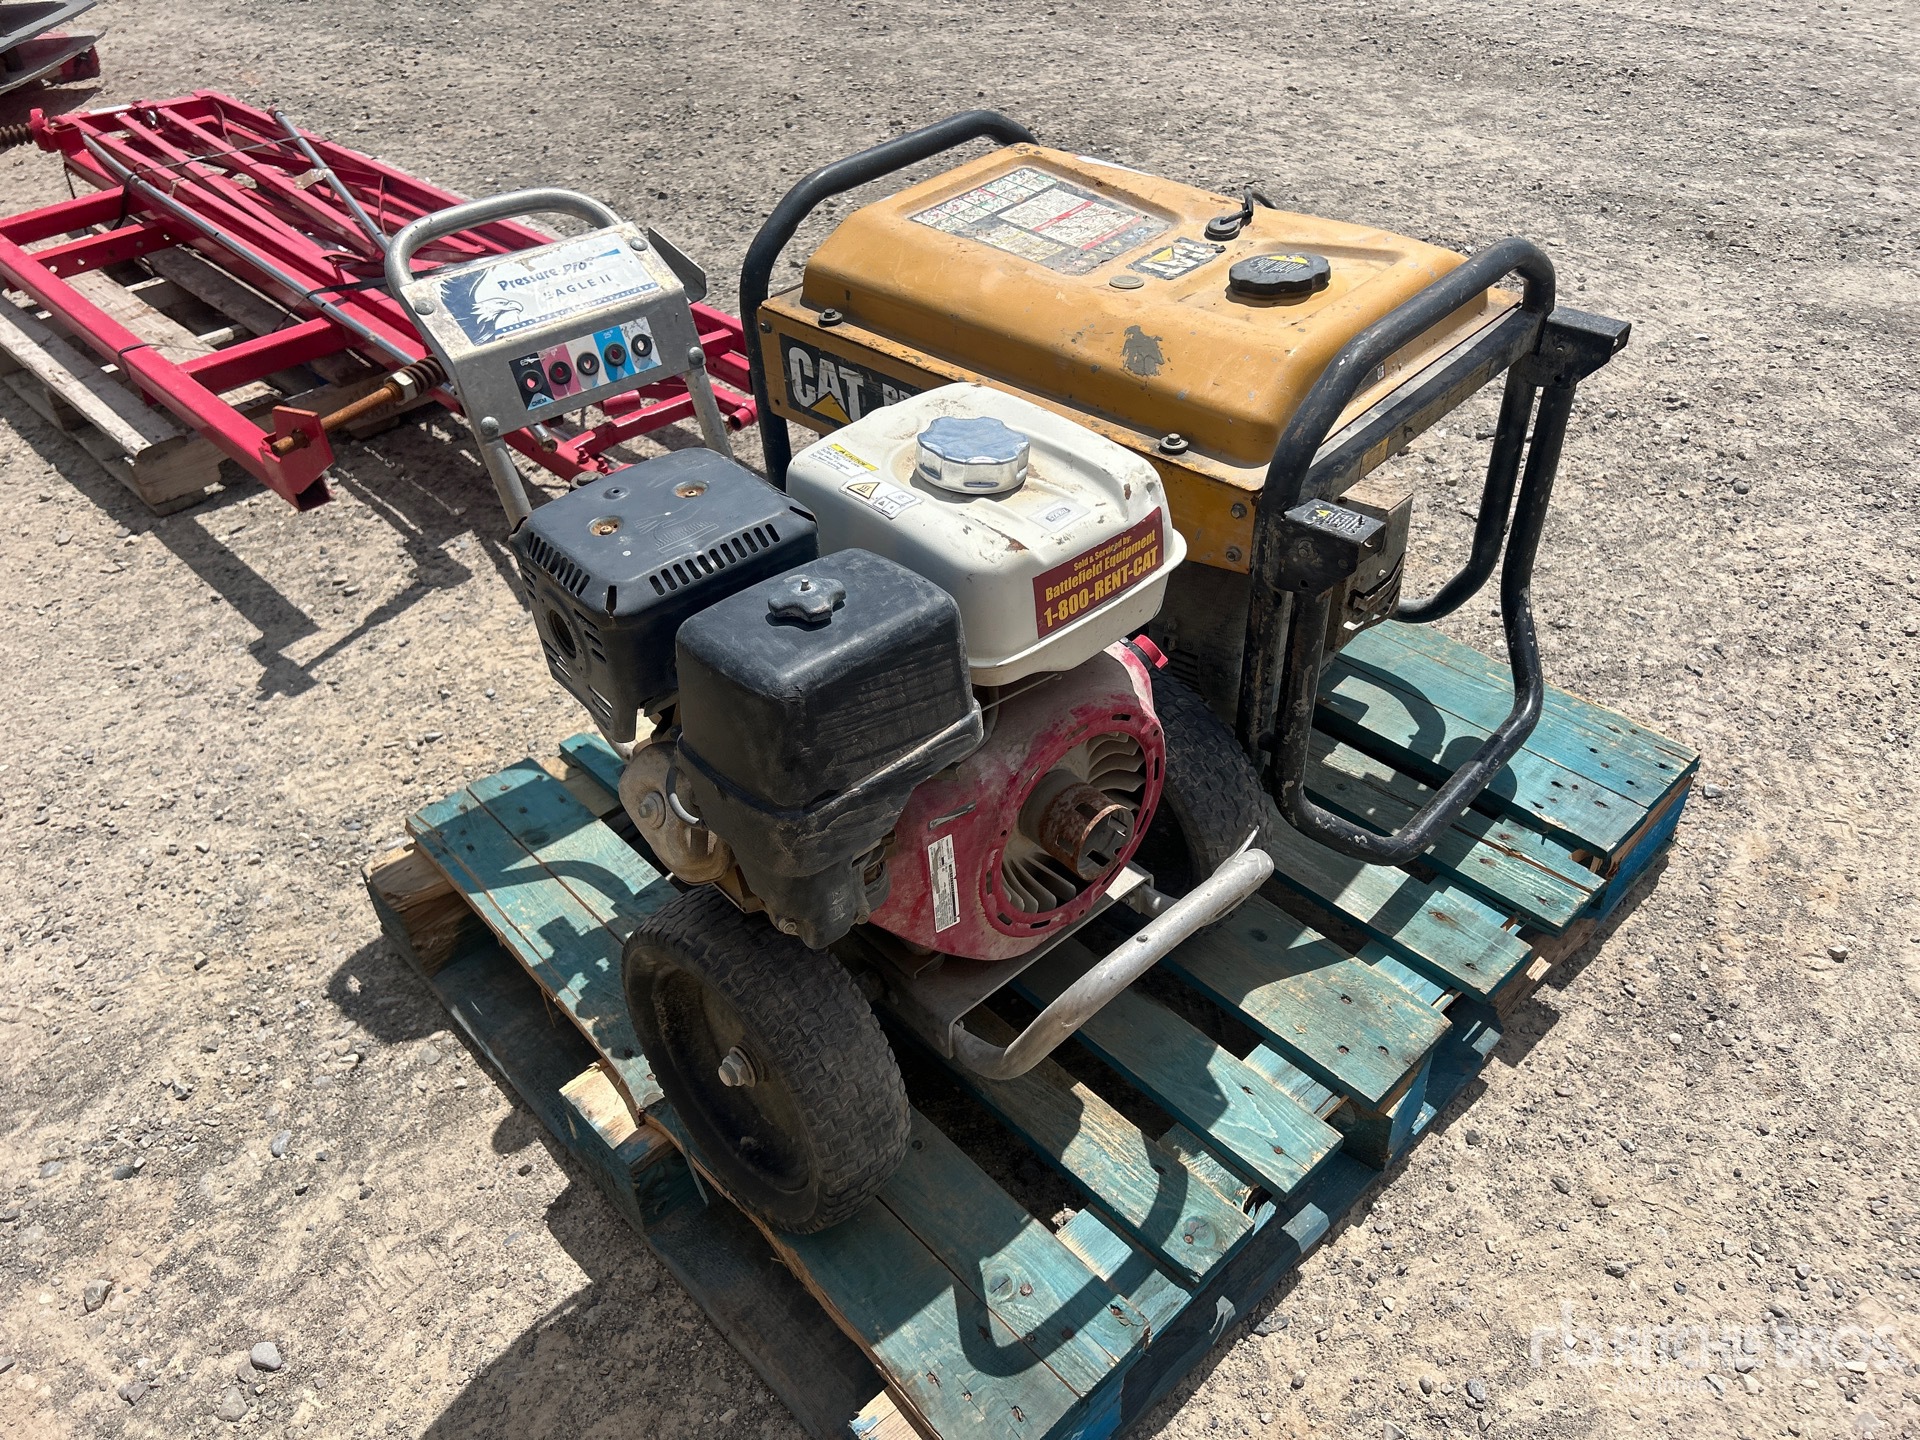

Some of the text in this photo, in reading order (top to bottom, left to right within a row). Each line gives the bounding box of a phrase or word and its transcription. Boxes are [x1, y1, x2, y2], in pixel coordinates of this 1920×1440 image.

[497, 268, 559, 291] Pressure
[600, 274, 612, 283] II
[788, 347, 864, 422] CAT
[845, 452, 868, 466] CAUTION
[1045, 529, 1156, 602] Battlefield Equipment
[1073, 556, 1089, 571] Sold
[1094, 538, 1123, 560] Serviced
[1043, 545, 1159, 628] 1-800-RENT-CAT
